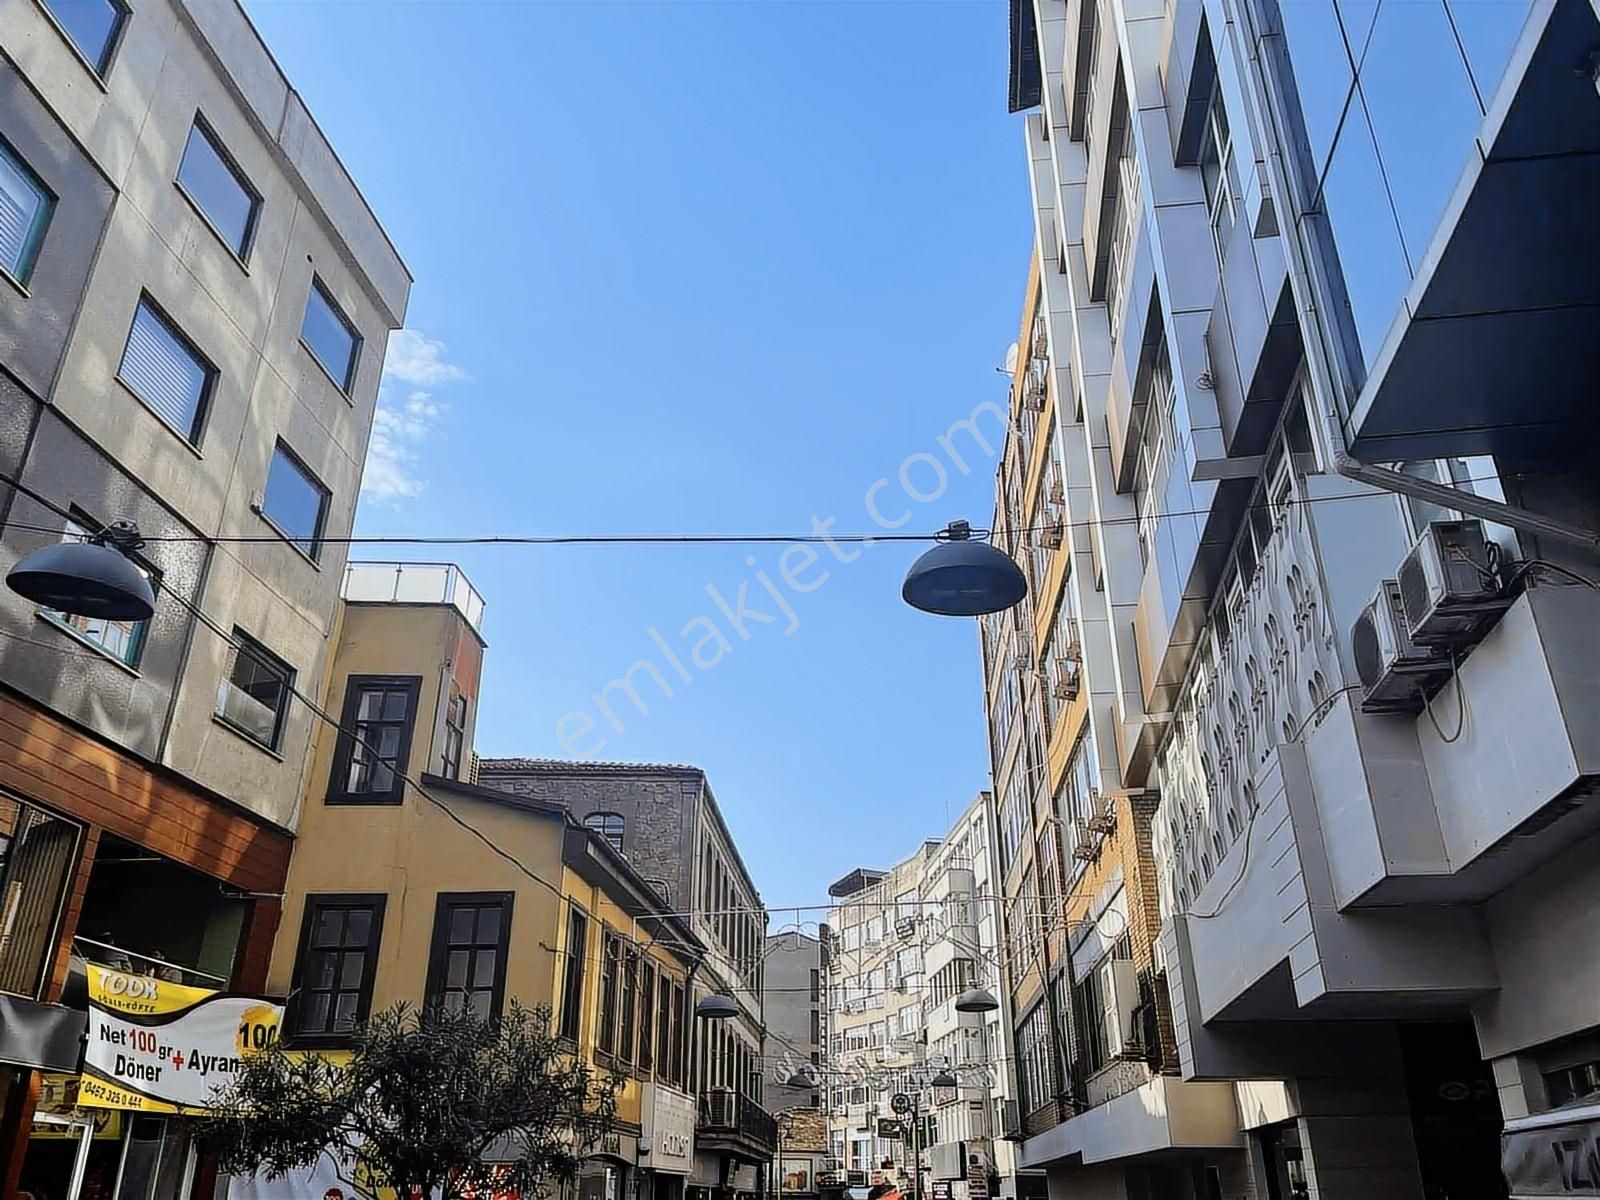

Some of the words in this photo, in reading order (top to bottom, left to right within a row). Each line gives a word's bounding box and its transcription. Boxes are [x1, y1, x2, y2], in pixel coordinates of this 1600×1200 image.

[100, 1023, 126, 1045] Net
[129, 1028, 157, 1053] 100
[158, 1045, 173, 1060] gr
[187, 1049, 240, 1076] Ayran
[114, 1053, 162, 1082] Döner
